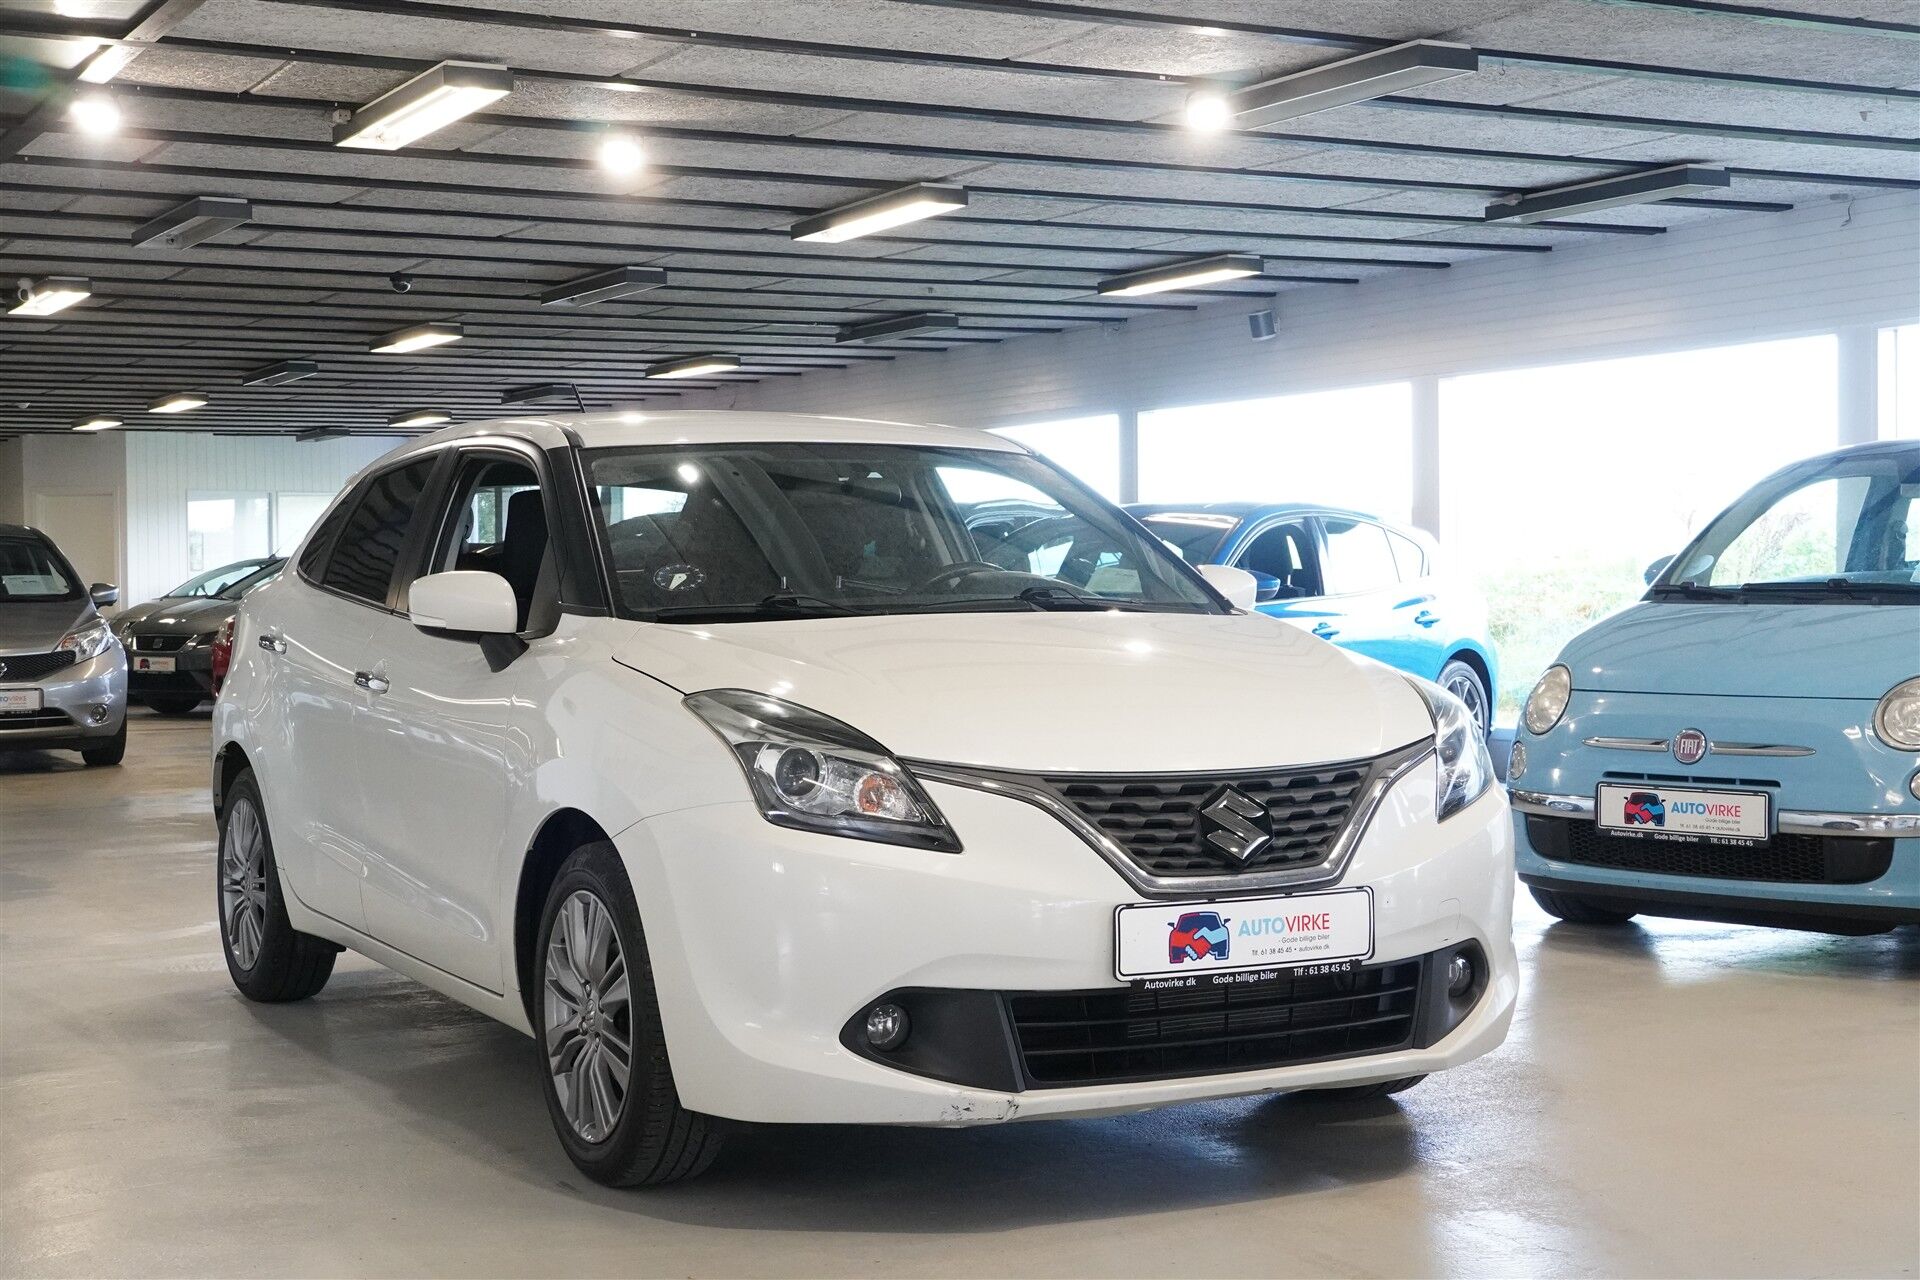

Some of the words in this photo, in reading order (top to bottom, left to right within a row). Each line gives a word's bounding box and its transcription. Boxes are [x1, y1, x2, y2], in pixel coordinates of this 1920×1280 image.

[1680, 738, 1700, 754] FIAT
[1671, 801, 1742, 818] AUTOVIRKE
[1669, 834, 1686, 843] billige
[1238, 913, 1330, 936] AUTOVIRKE
[1281, 936, 1298, 944] Gode
[1299, 935, 1317, 943] billige
[1260, 948, 1268, 956] 61
[1212, 974, 1234, 984] Gode
[1235, 972, 1259, 983] billige
[1260, 970, 1278, 981] biler
[1309, 966, 1319, 975] 61
[1320, 965, 1330, 974] 38
[1330, 964, 1340, 973] 45
[1341, 962, 1351, 972] 45
